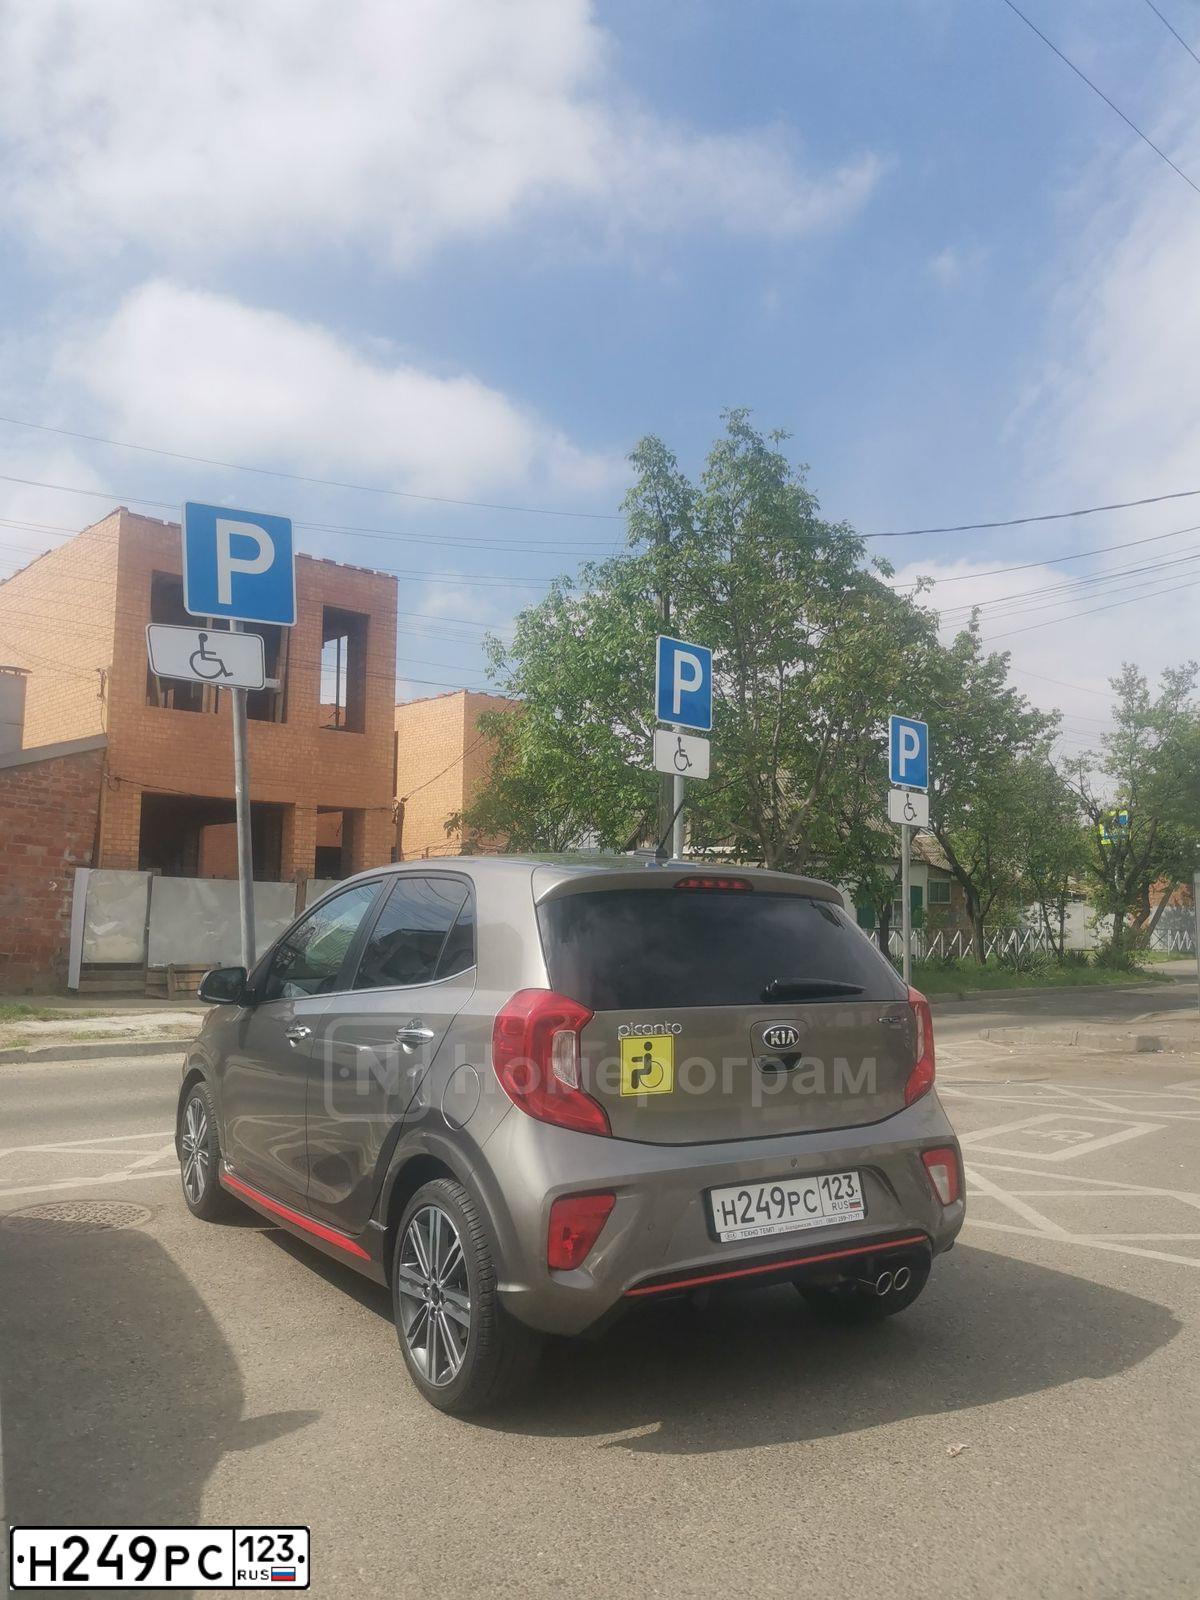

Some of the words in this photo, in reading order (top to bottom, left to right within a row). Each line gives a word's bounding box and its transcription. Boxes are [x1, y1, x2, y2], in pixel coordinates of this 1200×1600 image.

[215, 518, 276, 606] P
[672, 649, 704, 715] P
[898, 725, 921, 777] P
[617, 1020, 684, 1041] picanto
[770, 1029, 796, 1046] KIA
[821, 1174, 855, 1202] 123
[831, 1200, 849, 1211] RUS
